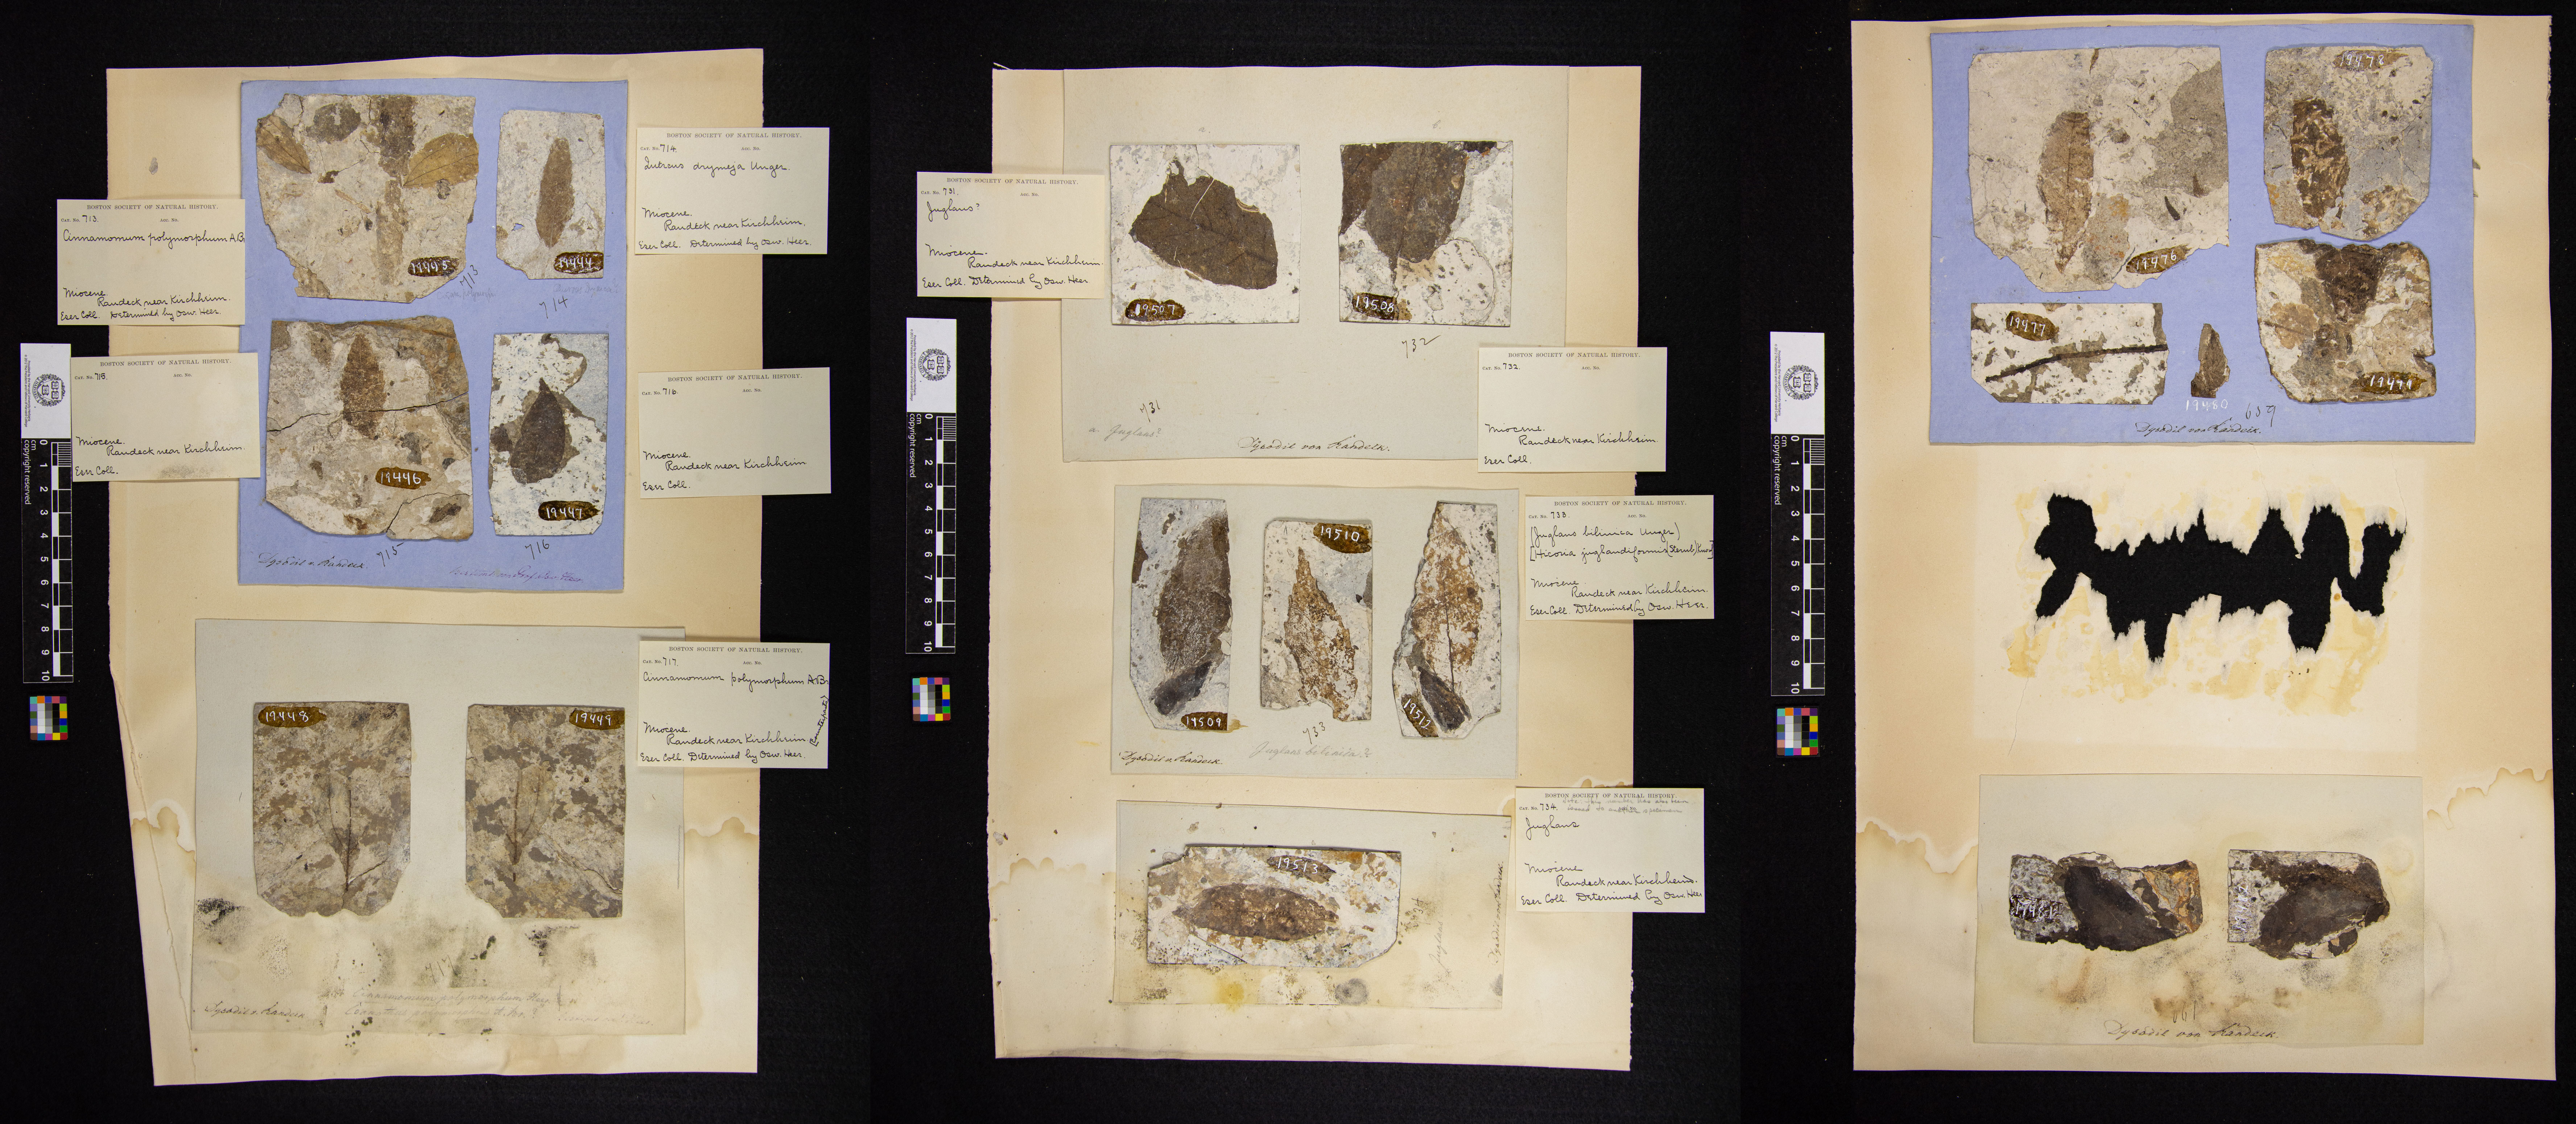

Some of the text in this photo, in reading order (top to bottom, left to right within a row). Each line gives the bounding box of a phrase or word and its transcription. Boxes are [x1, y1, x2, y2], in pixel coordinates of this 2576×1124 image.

[2340, 54, 2384, 67] 19478
[751, 161, 790, 178] Unger.
[641, 207, 692, 218] Miocene.
[63, 229, 228, 249] Cinnamomum polymorphum
[660, 240, 681, 249] Coll.
[690, 238, 742, 248] Determined
[746, 237, 759, 250] by
[787, 236, 812, 246] Heer.
[560, 257, 591, 269] 19444
[2137, 249, 2177, 270] 19476
[63, 287, 108, 299] Miocene.
[1135, 303, 1175, 316] 19507
[1356, 296, 1394, 312] 19508
[2010, 315, 2045, 337] 19477
[2186, 399, 2228, 411] 19480
[917, 414, 921, 424] cm
[31, 440, 36, 450] cm
[1782, 436, 1787, 447] cm
[1773, 436, 1782, 471] copyright
[381, 472, 421, 485] 19446
[546, 507, 582, 519] 19447
[1321, 526, 1359, 542] 19510
[42, 671, 50, 681] 10
[643, 672, 724, 682] Cinnamomum
[731, 672, 804, 692] polymorphum
[266, 711, 308, 722] 19448
[576, 713, 611, 726] 19449
[1403, 698, 1431, 730] 19512
[1186, 717, 1221, 727] 19509
[1526, 815, 1580, 840] Juglans
[1277, 857, 1318, 874] 19513
